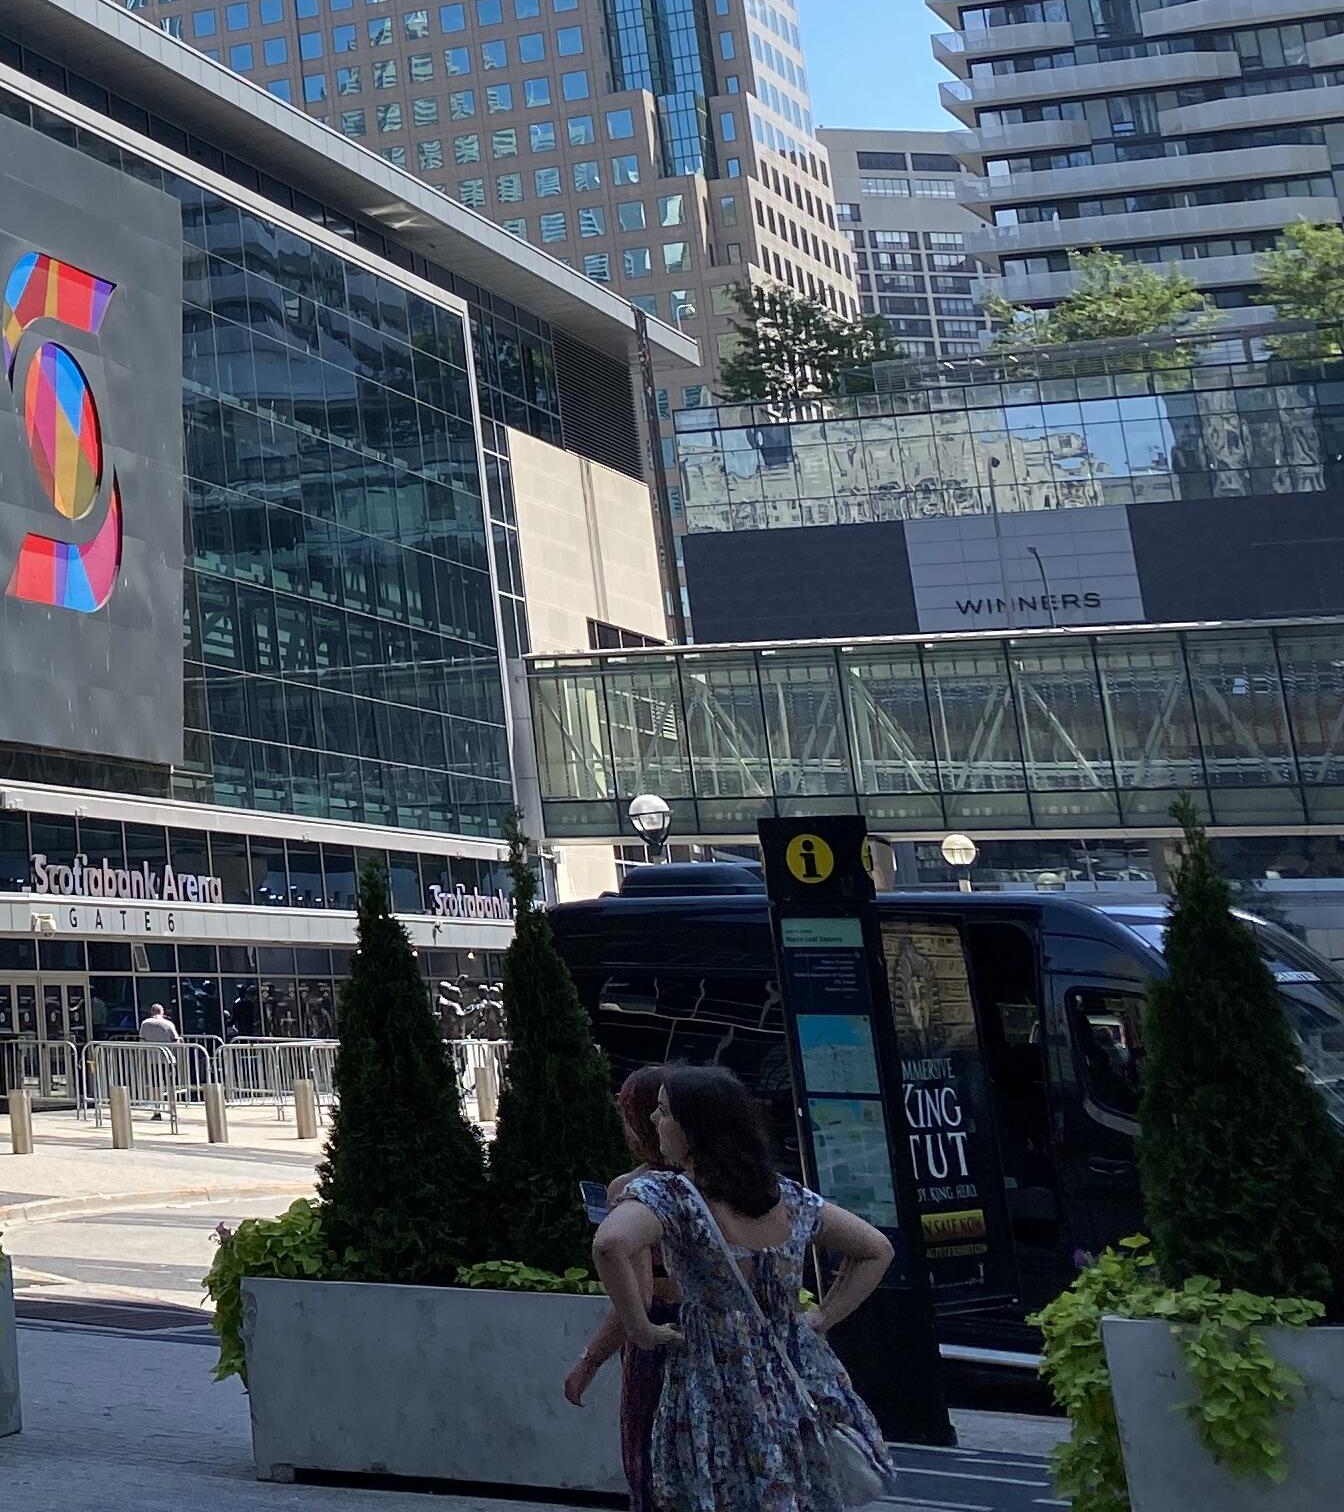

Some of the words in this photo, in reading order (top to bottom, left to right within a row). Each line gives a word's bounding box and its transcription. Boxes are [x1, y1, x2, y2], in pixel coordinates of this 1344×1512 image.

[955, 592, 1102, 615] WINNERS
[30, 853, 156, 900] Scotiabank
[163, 864, 223, 904] Arena
[428, 883, 510, 920] Scotiabank
[69, 907, 152, 932] GATE
[168, 912, 175, 933] 6
[901, 1057, 956, 1081] MMERSIVE
